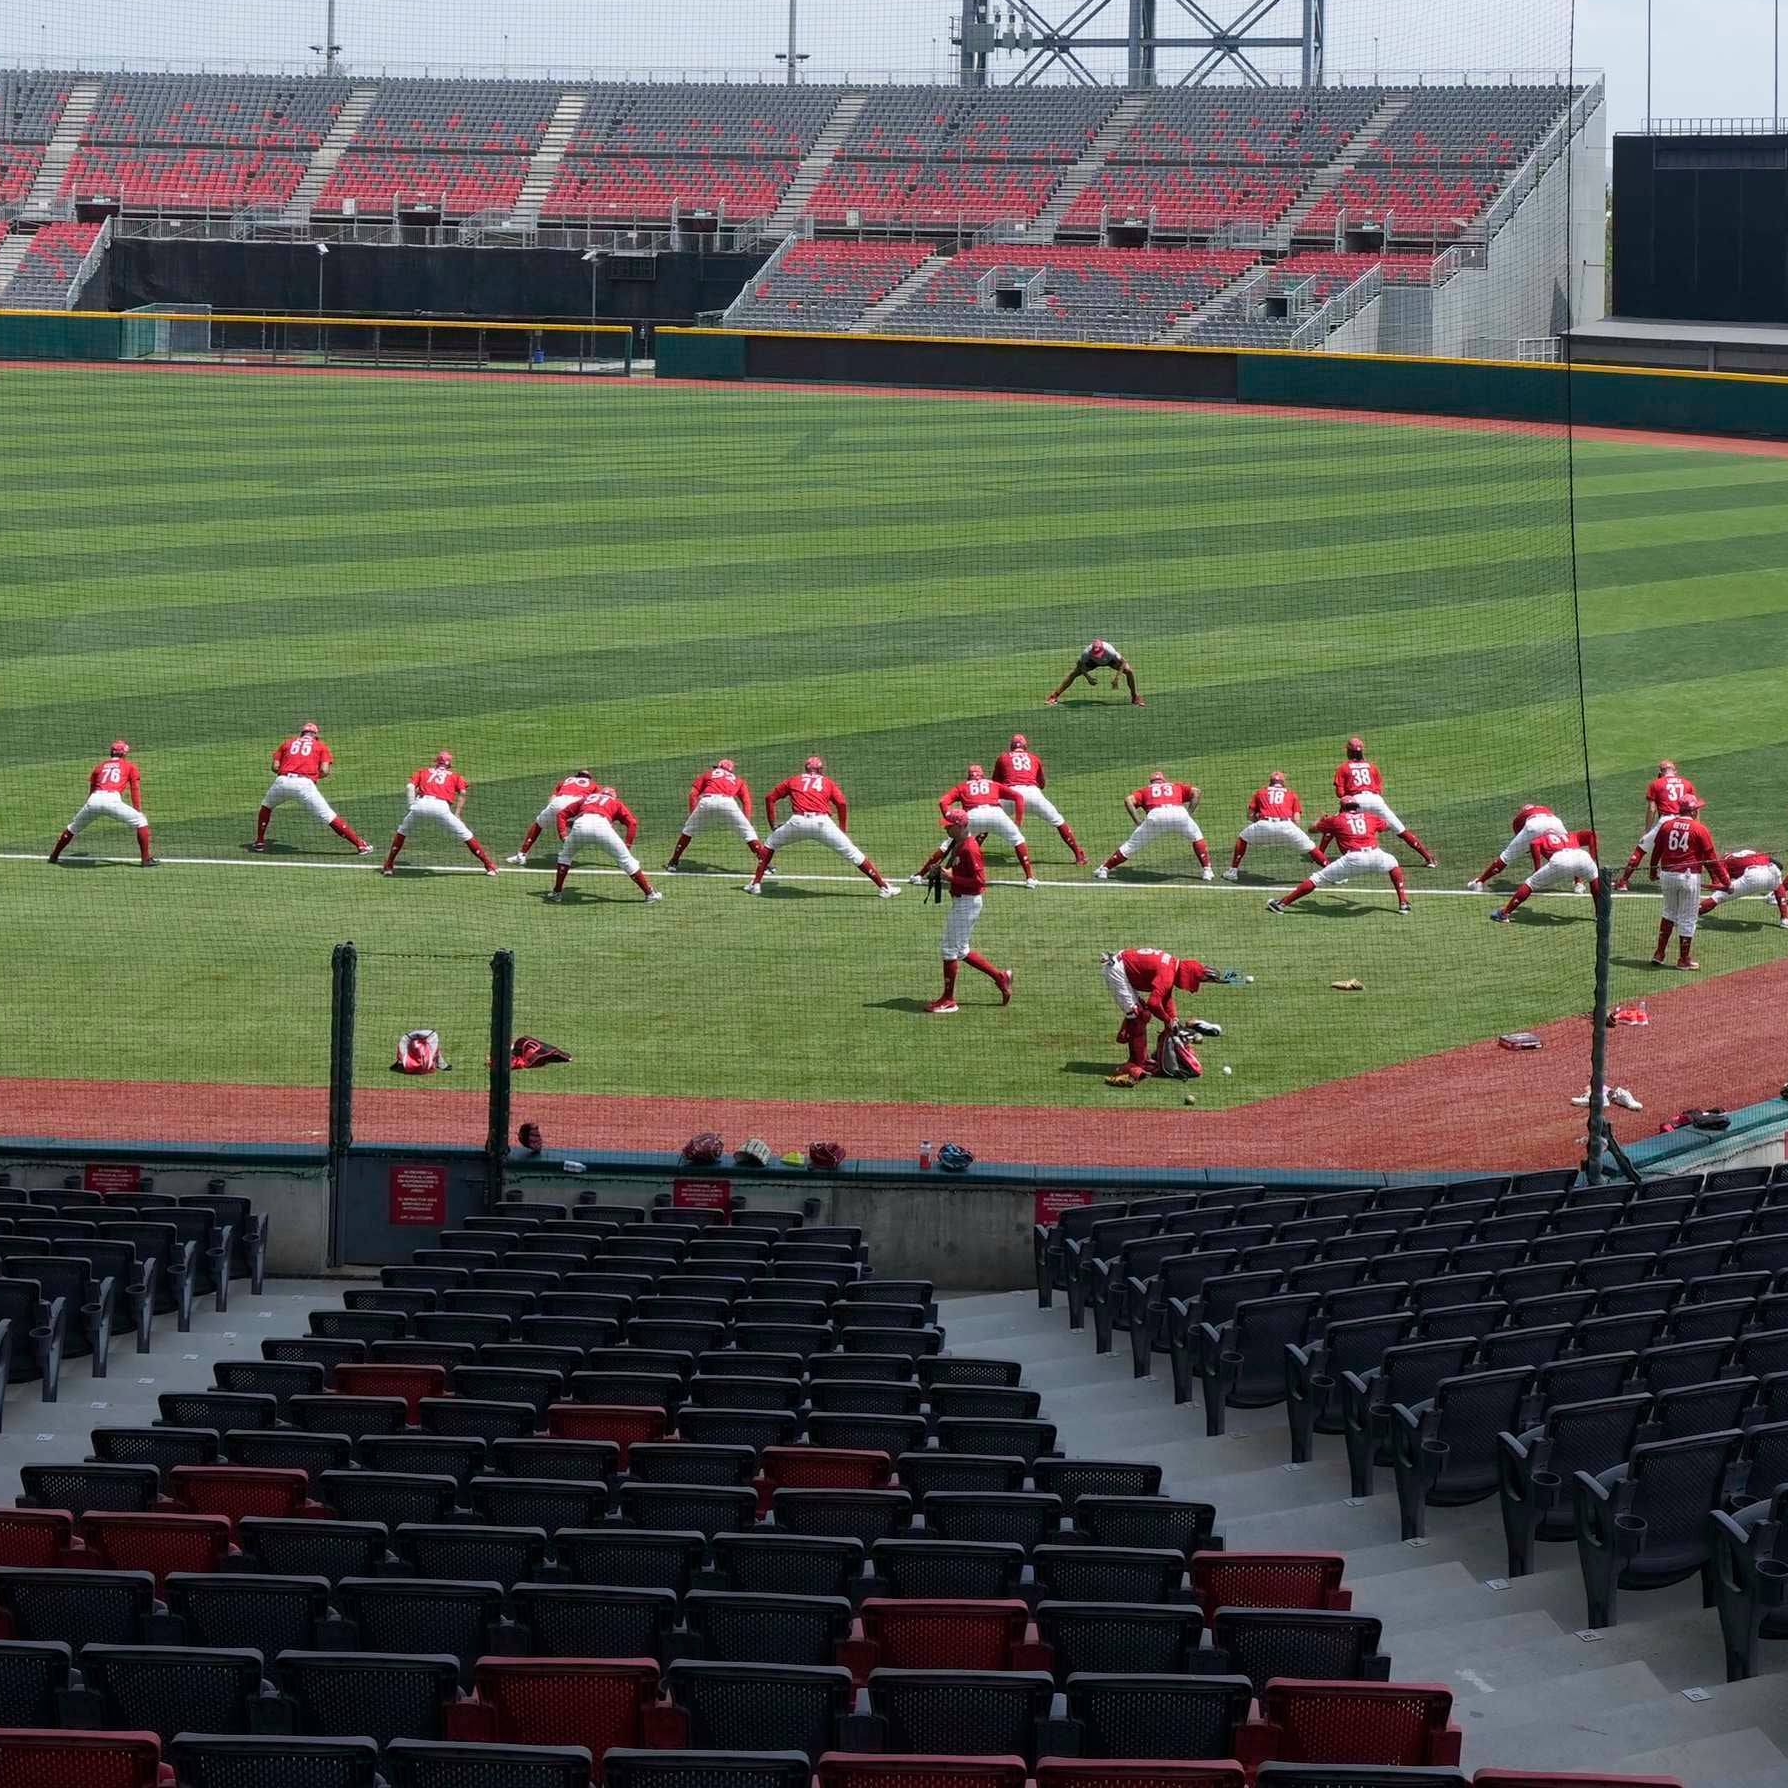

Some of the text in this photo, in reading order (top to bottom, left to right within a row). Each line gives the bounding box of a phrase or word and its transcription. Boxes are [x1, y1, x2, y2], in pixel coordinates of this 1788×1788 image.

[289, 740, 313, 756] 65
[1012, 756, 1032, 771] 93
[101, 768, 121, 784] 76
[1351, 768, 1372, 787] 38
[801, 777, 824, 792] 74
[1665, 783, 1685, 801] 37
[1346, 818, 1367, 835] 19
[1668, 830, 1690, 853] 64
